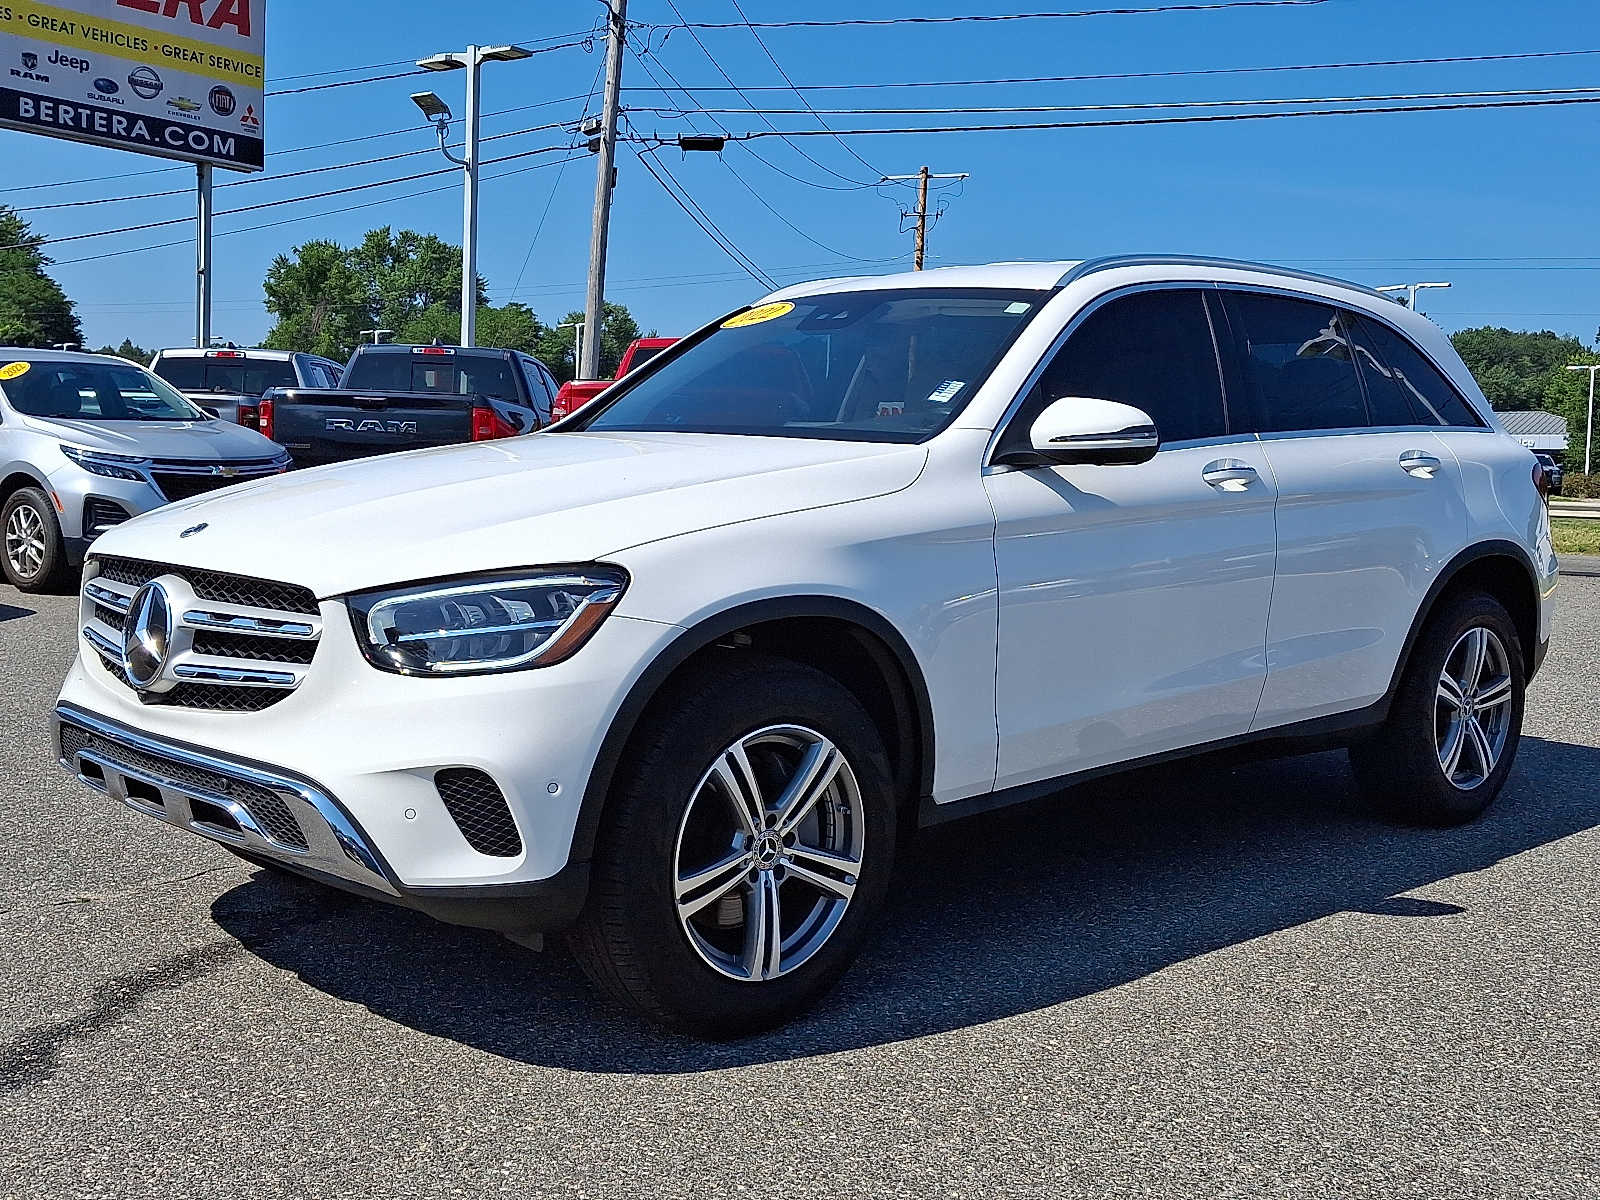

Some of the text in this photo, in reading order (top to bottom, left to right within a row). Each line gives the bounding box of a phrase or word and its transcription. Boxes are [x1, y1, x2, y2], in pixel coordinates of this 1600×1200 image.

[27, 13, 76, 36] GREAT
[80, 25, 148, 52] VEHICLES
[161, 44, 204, 66] GREAT
[209, 55, 261, 78] SERVICE
[48, 49, 90, 73] Jeep
[10, 68, 50, 83] RAM
[87, 92, 125, 105] SUBARU
[215, 93, 231, 109] FIAT
[167, 110, 200, 120] CHEVROLET
[19, 97, 236, 156] BERTERA.COM
[325, 418, 417, 433] RAM
